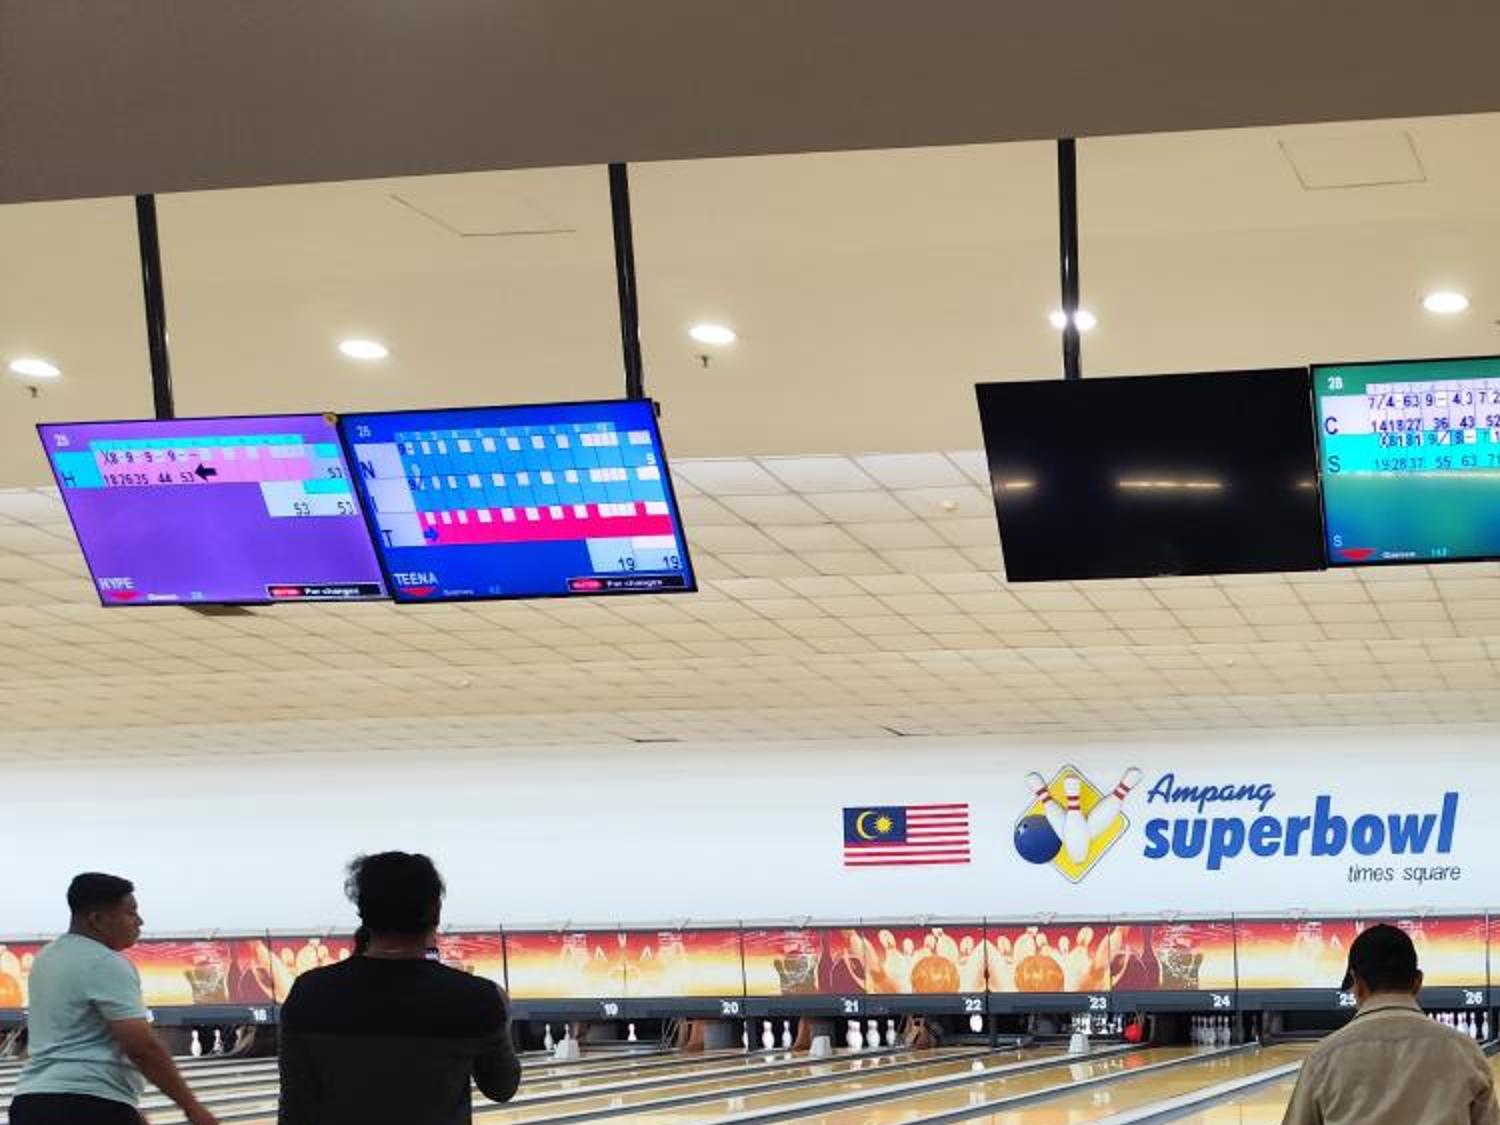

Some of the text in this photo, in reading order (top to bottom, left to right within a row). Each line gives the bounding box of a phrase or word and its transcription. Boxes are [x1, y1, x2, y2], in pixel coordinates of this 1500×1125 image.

[1324, 415, 1339, 435] C
[1459, 415, 1475, 429] 43
[360, 460, 376, 479] N
[1328, 455, 1341, 473] S
[62, 470, 77, 487] H
[381, 529, 393, 547] T
[618, 555, 679, 571] 19 19
[1147, 773, 1276, 814] Ampang
[1144, 791, 1459, 870] superbowl
[1348, 864, 1461, 884] times square
[965, 998, 982, 1011] 22
[1089, 997, 1107, 1009] 23
[1213, 995, 1231, 1007] 24
[1339, 993, 1356, 1006] 25
[1465, 991, 1483, 1004] 26
[603, 1003, 619, 1016] 19
[722, 1001, 739, 1014] 20
[844, 1000, 859, 1012] 21
